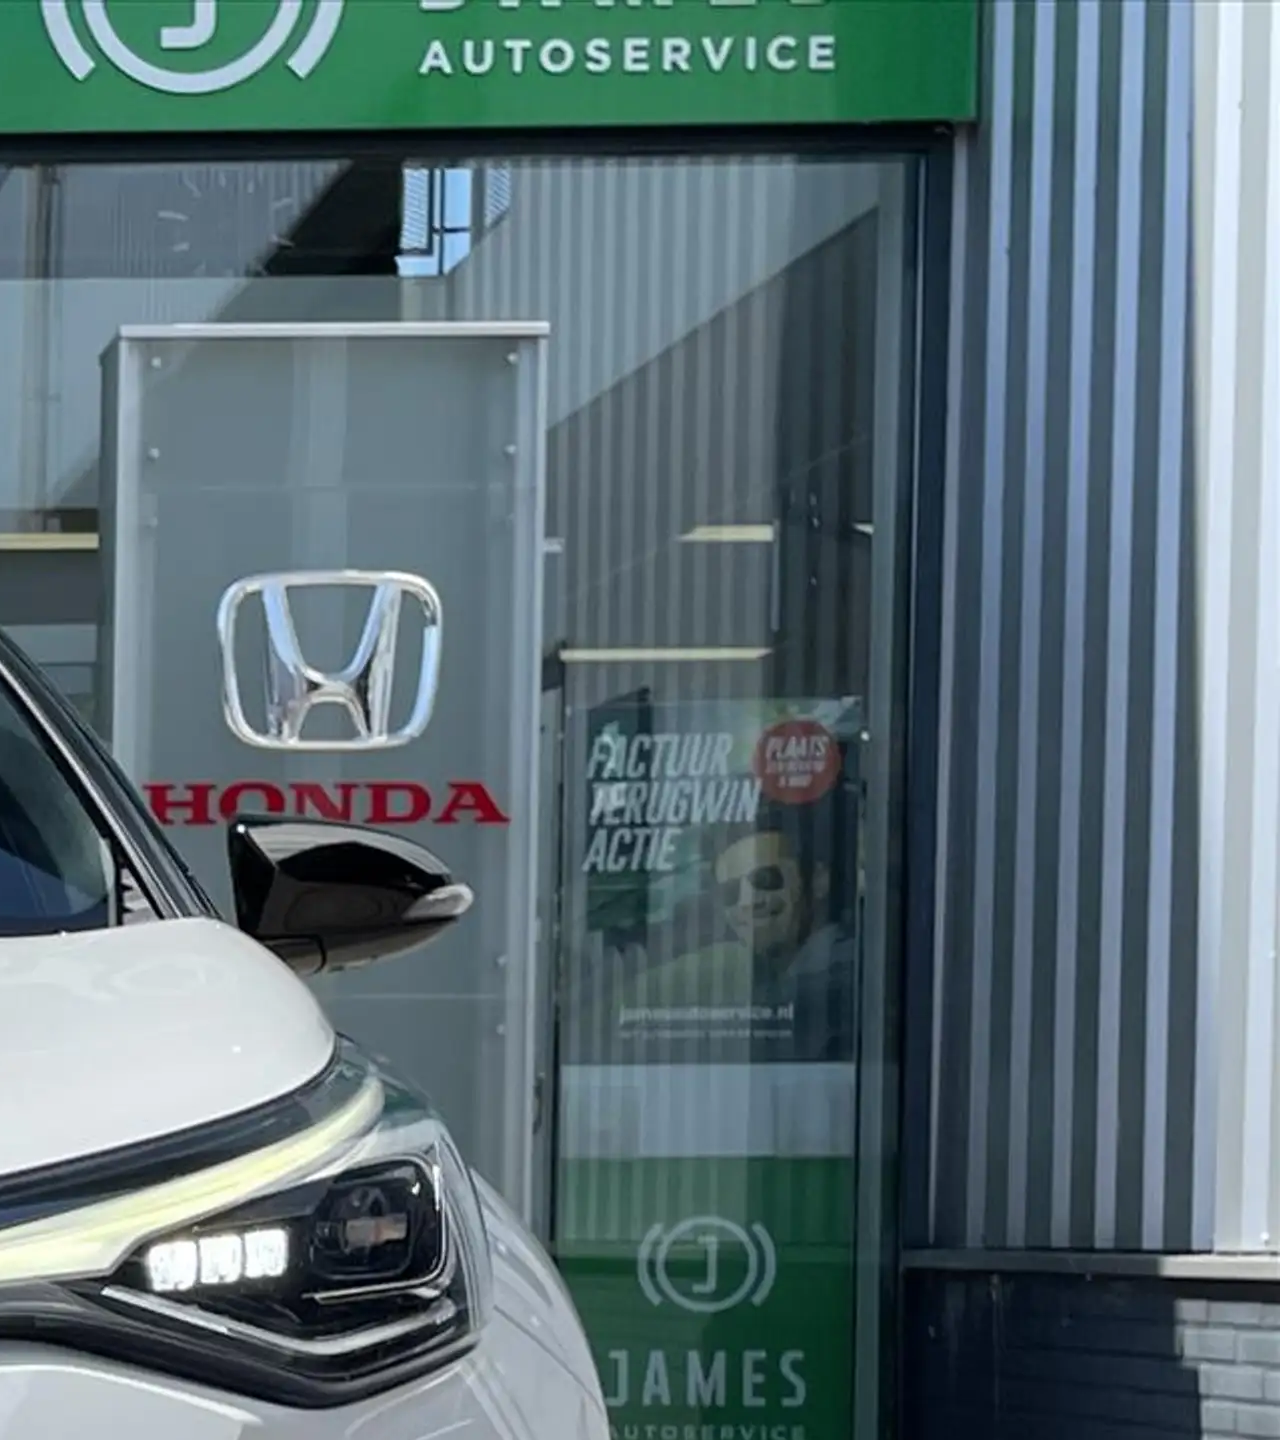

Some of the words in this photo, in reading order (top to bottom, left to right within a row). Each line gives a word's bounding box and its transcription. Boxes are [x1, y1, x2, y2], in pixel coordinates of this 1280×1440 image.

[418, 35, 837, 75] AUTOSERVICE
[587, 733, 734, 780] FACTUUR
[143, 782, 511, 826] HONDA
[590, 777, 763, 826] TERUGWIN
[581, 827, 684, 873] ACTIE
[604, 1348, 807, 1408] JAMES
